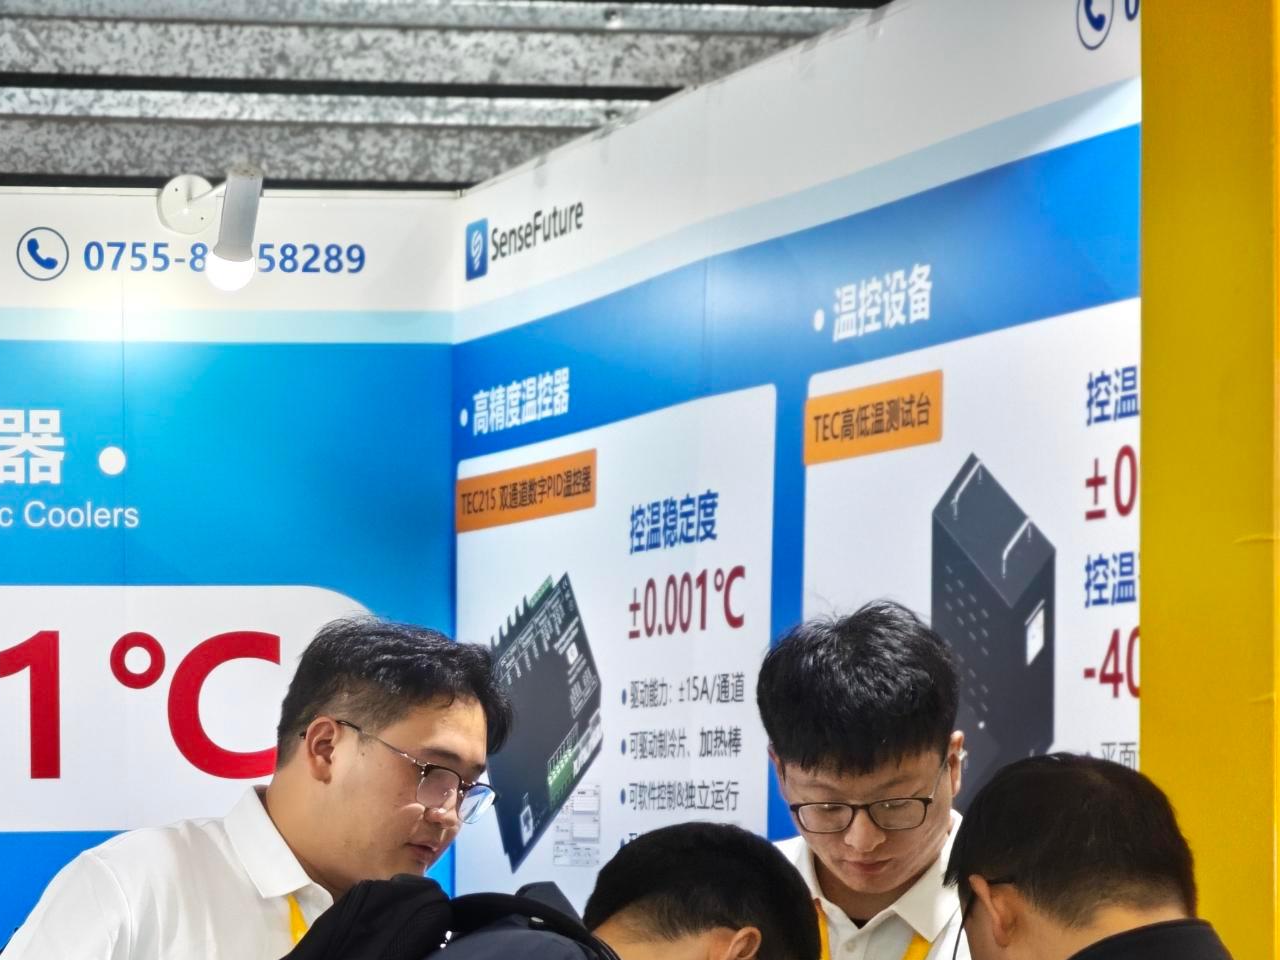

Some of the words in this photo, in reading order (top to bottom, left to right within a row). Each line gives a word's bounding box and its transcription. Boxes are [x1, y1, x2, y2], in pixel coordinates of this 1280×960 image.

[83, 240, 367, 274] 0755-858289
[491, 201, 584, 262] SenseFuture
[832, 263, 932, 343] 温控设备
[472, 367, 570, 437] 高精度温控器
[814, 392, 932, 443] TEC高低温测试台
[23, 500, 140, 530] Coolers
[461, 488, 497, 516] TEC215
[499, 465, 592, 511] 双通道数字PID温控器
[629, 489, 719, 555] 控温稳定度
[629, 725, 742, 760] 可驱动制冷片、加热棒
[629, 779, 740, 812] 可软件控制&独立运行
